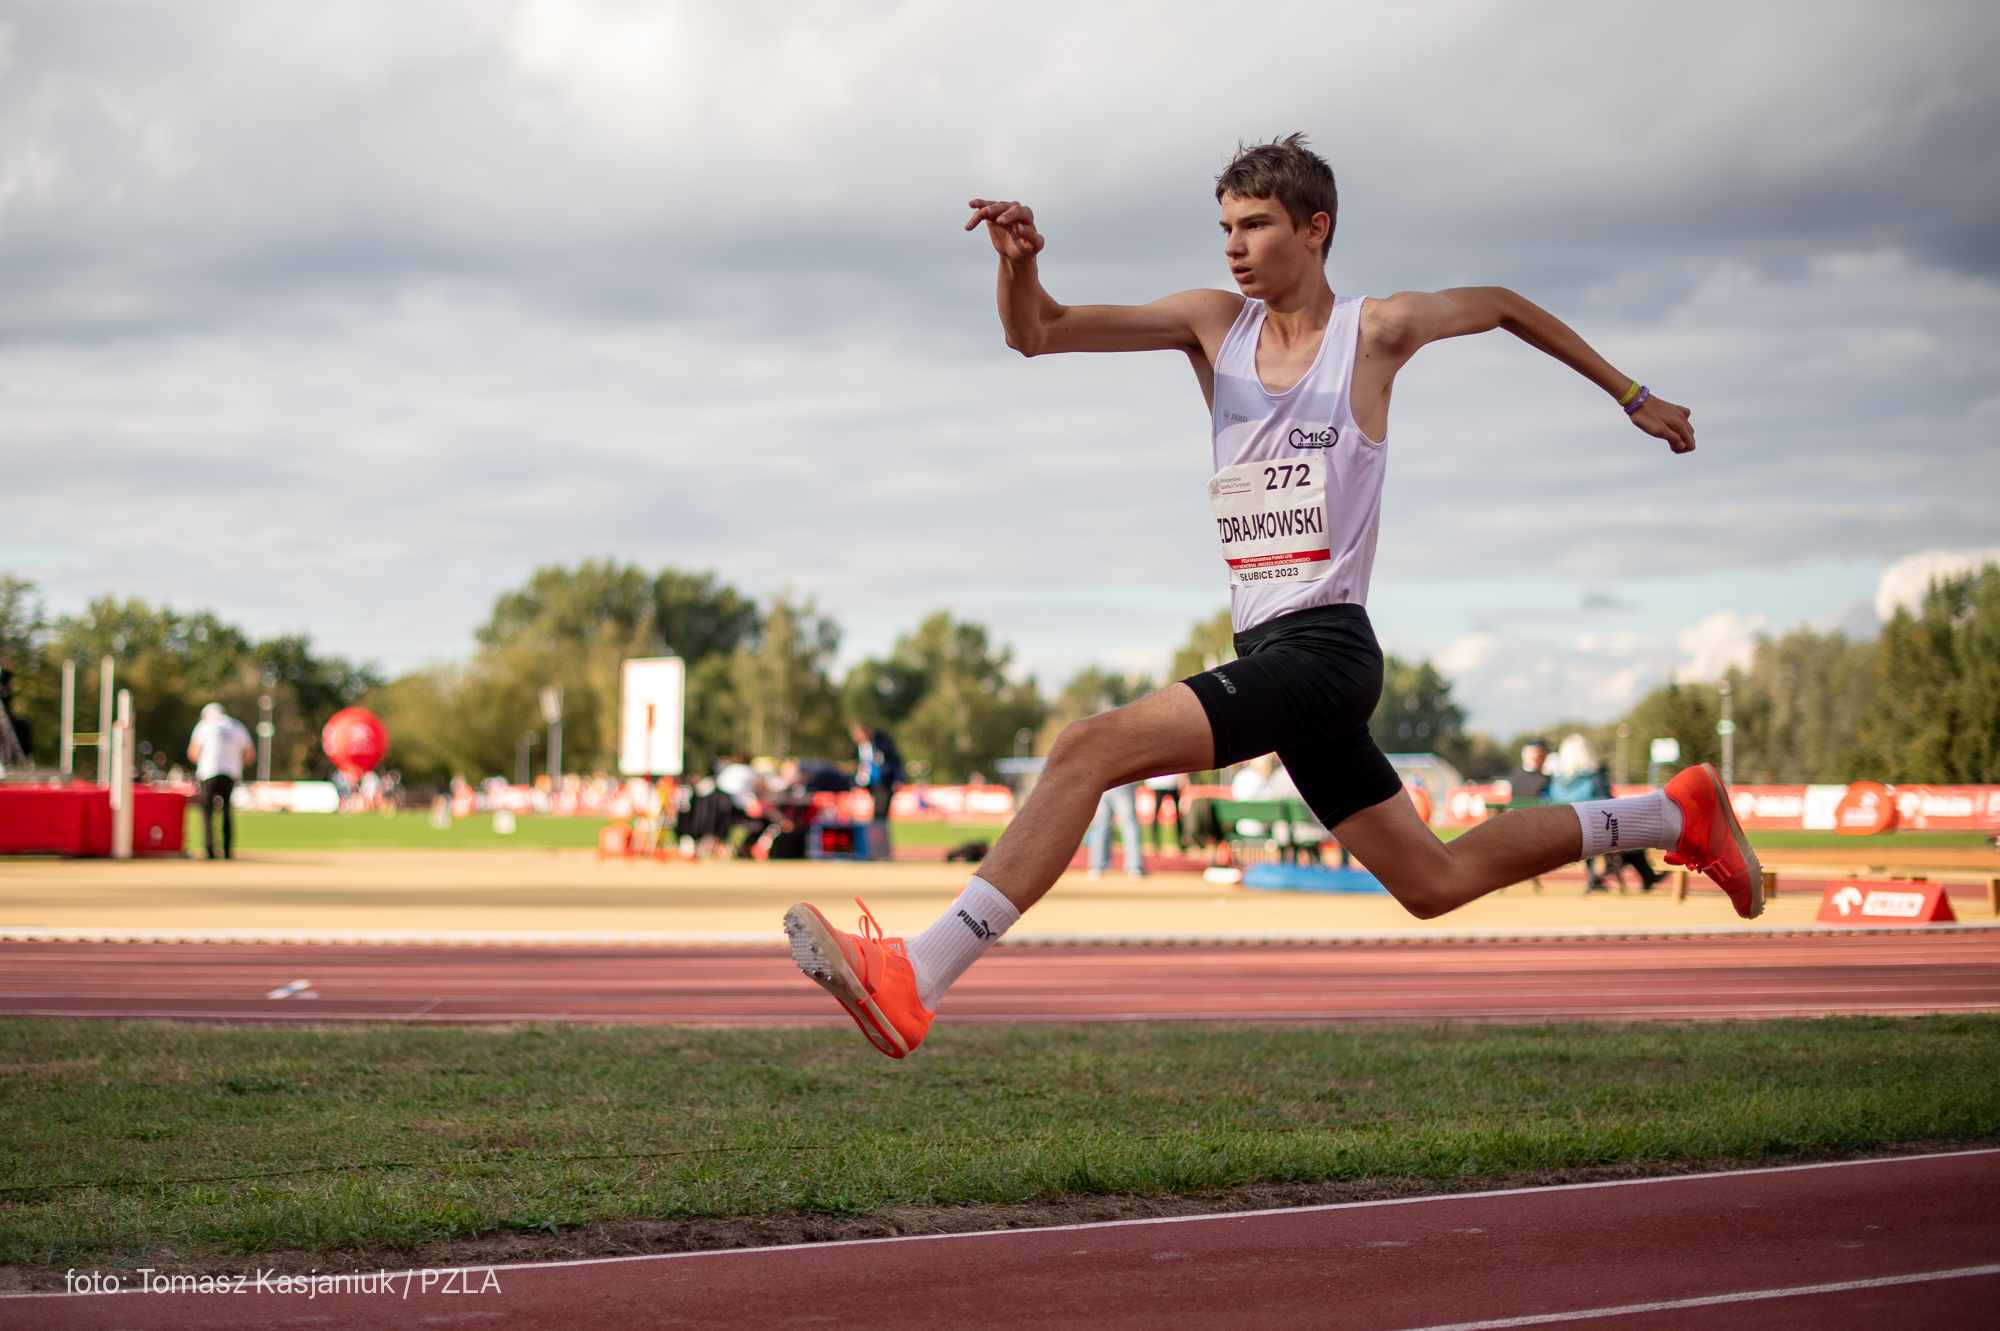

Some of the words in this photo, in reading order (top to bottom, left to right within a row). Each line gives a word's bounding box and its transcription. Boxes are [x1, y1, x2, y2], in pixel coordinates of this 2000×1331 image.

[1230, 413, 1248, 423] JAKO
[1263, 463, 1311, 491] 272
[1216, 506, 1323, 544] ZDRAJKOWSKI
[1240, 570, 1273, 582] SŁUBICE
[1274, 567, 1299, 578] 2023
[1212, 671, 1237, 695] JAKO
[1610, 818, 1619, 847] PUMA
[957, 909, 986, 939] PUMA
